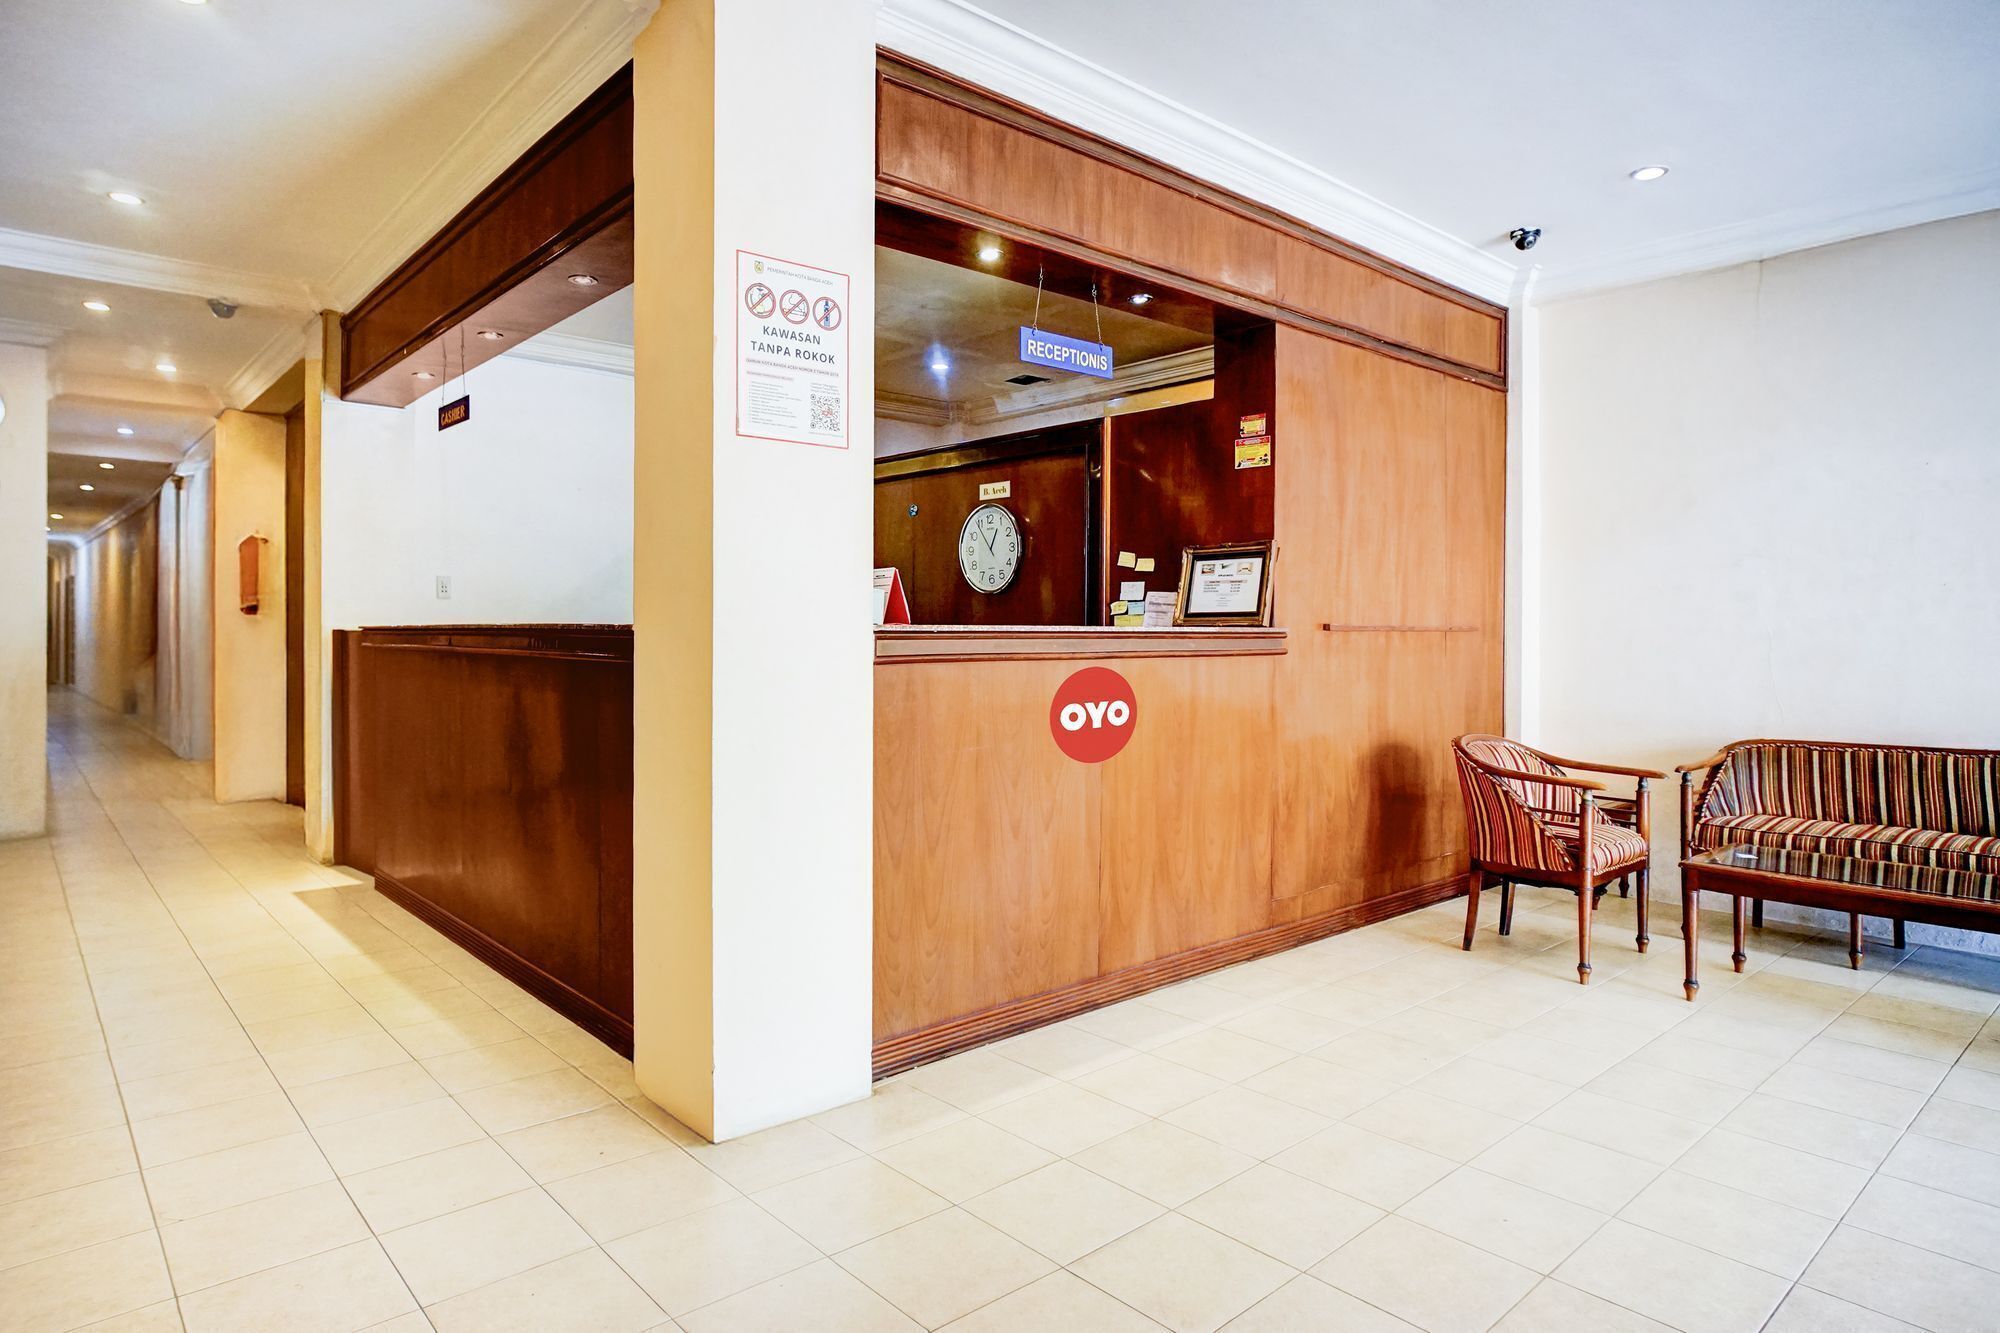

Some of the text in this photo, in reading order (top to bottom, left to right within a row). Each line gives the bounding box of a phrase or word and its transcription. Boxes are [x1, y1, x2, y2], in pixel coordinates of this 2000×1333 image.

[763, 325, 821, 345] KAWASAN
[751, 340, 835, 364] TANPA ROKOK
[1028, 339, 1108, 371] RECEPTIONIS
[441, 404, 465, 426] CASHIER
[992, 486, 1006, 495] Aceh
[986, 514, 994, 525] 12
[969, 531, 978, 542] 10
[1005, 526, 1012, 538] 2
[968, 545, 975, 557] 9
[1008, 541, 1016, 553] 3
[971, 560, 978, 571] 8
[1005, 557, 1012, 568] 4
[979, 570, 986, 581] 7
[988, 574, 996, 585] 6
[998, 569, 1006, 580] 5
[1060, 700, 1130, 731] OYO
